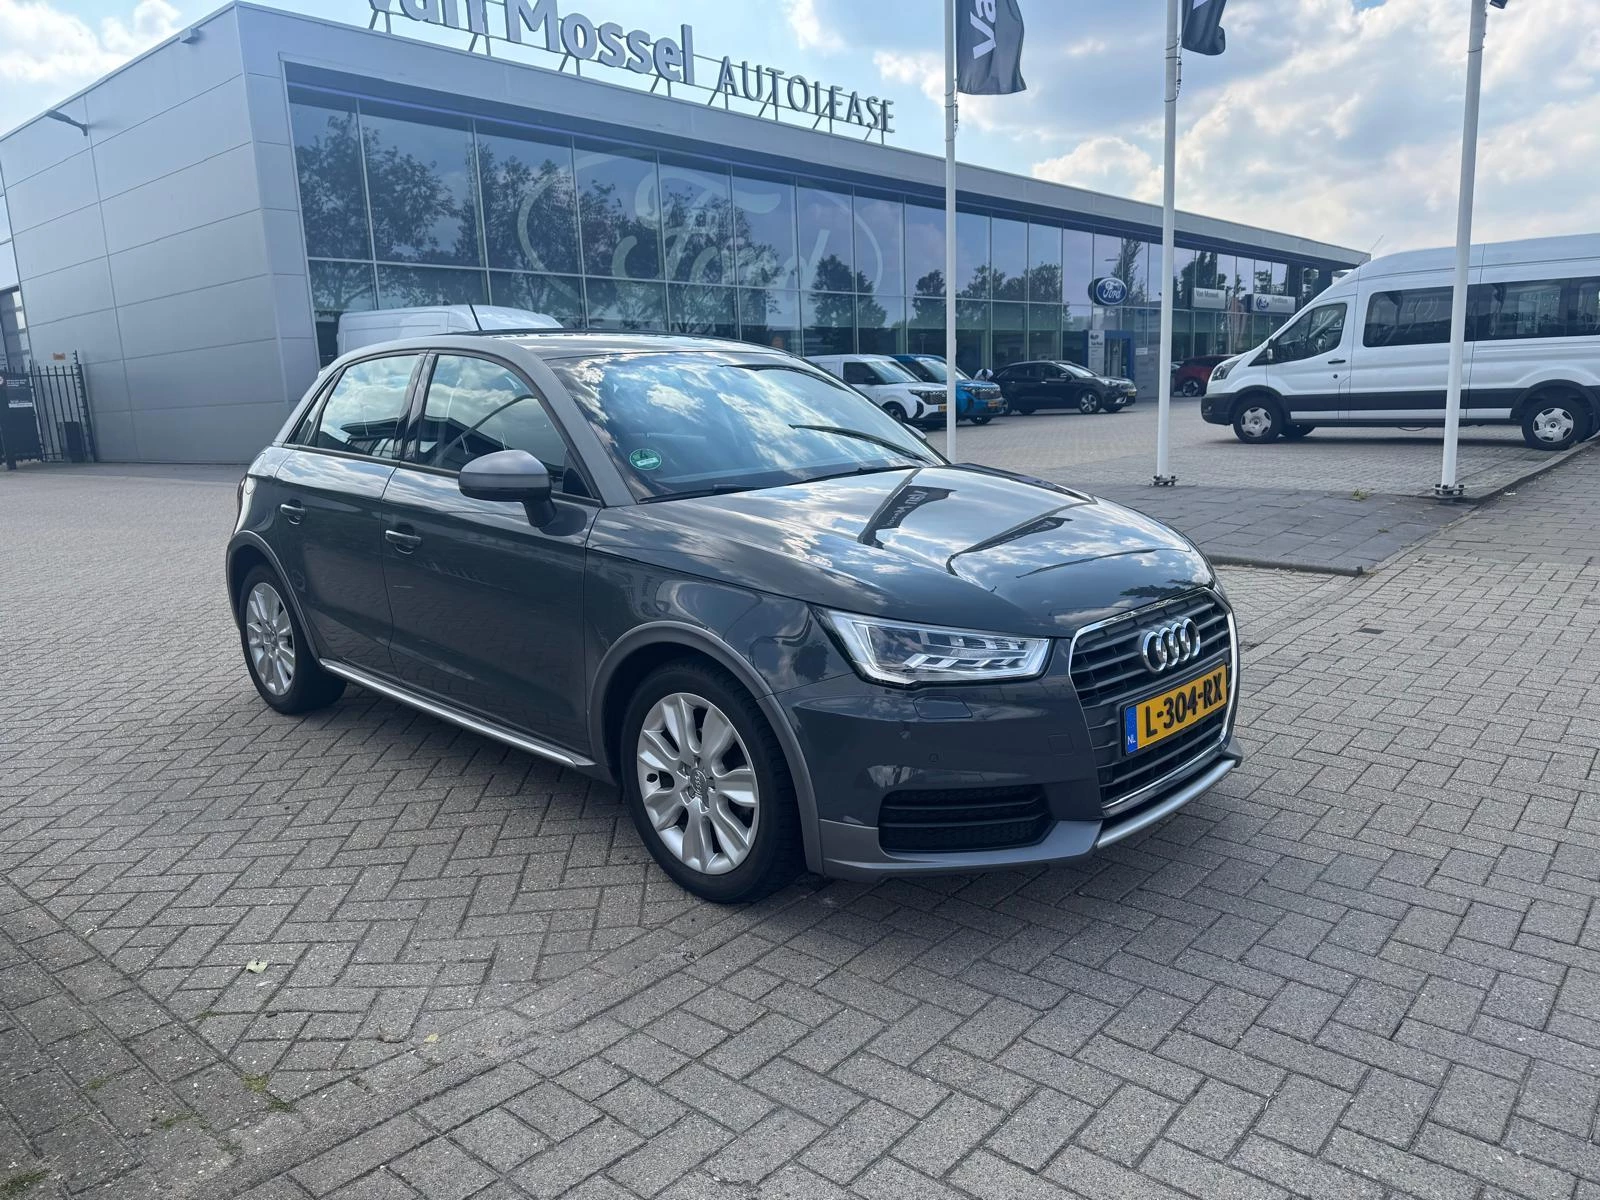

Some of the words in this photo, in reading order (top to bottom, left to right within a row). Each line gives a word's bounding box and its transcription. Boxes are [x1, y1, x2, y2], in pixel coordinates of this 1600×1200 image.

[505, 0, 695, 85] Mossel
[716, 55, 896, 134] AUTOLEASE
[1102, 280, 1123, 299] Ford
[1145, 672, 1223, 738] L-304-RX
[1127, 735, 1137, 745] NL
